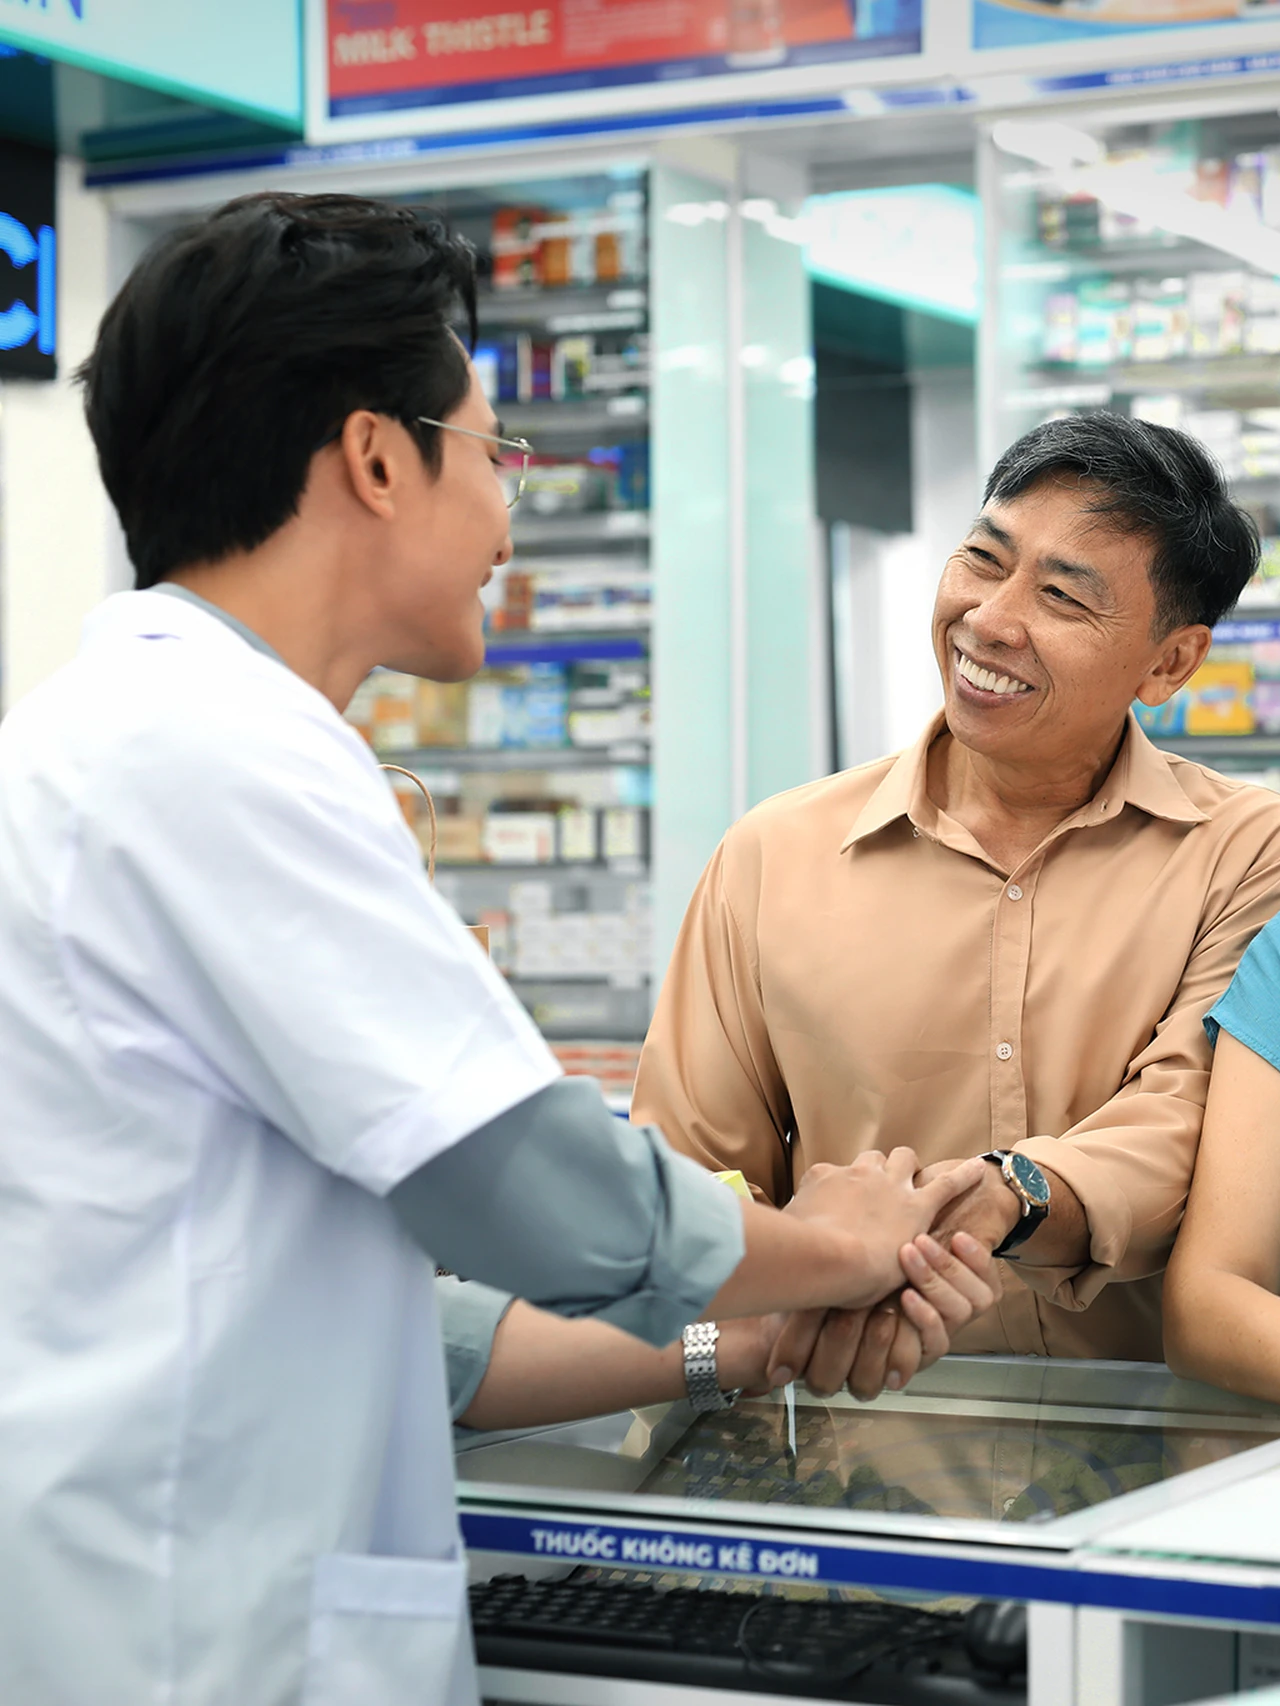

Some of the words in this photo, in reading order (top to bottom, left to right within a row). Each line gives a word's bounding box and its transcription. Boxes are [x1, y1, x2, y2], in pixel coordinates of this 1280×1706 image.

[334, 26, 416, 67] MILK
[423, 9, 552, 56] THISTLE
[531, 1527, 617, 1559] THUỐC
[621, 1535, 714, 1568] KHÔNG
[718, 1542, 754, 1570] KÊ
[758, 1546, 819, 1578] ĐƠN
